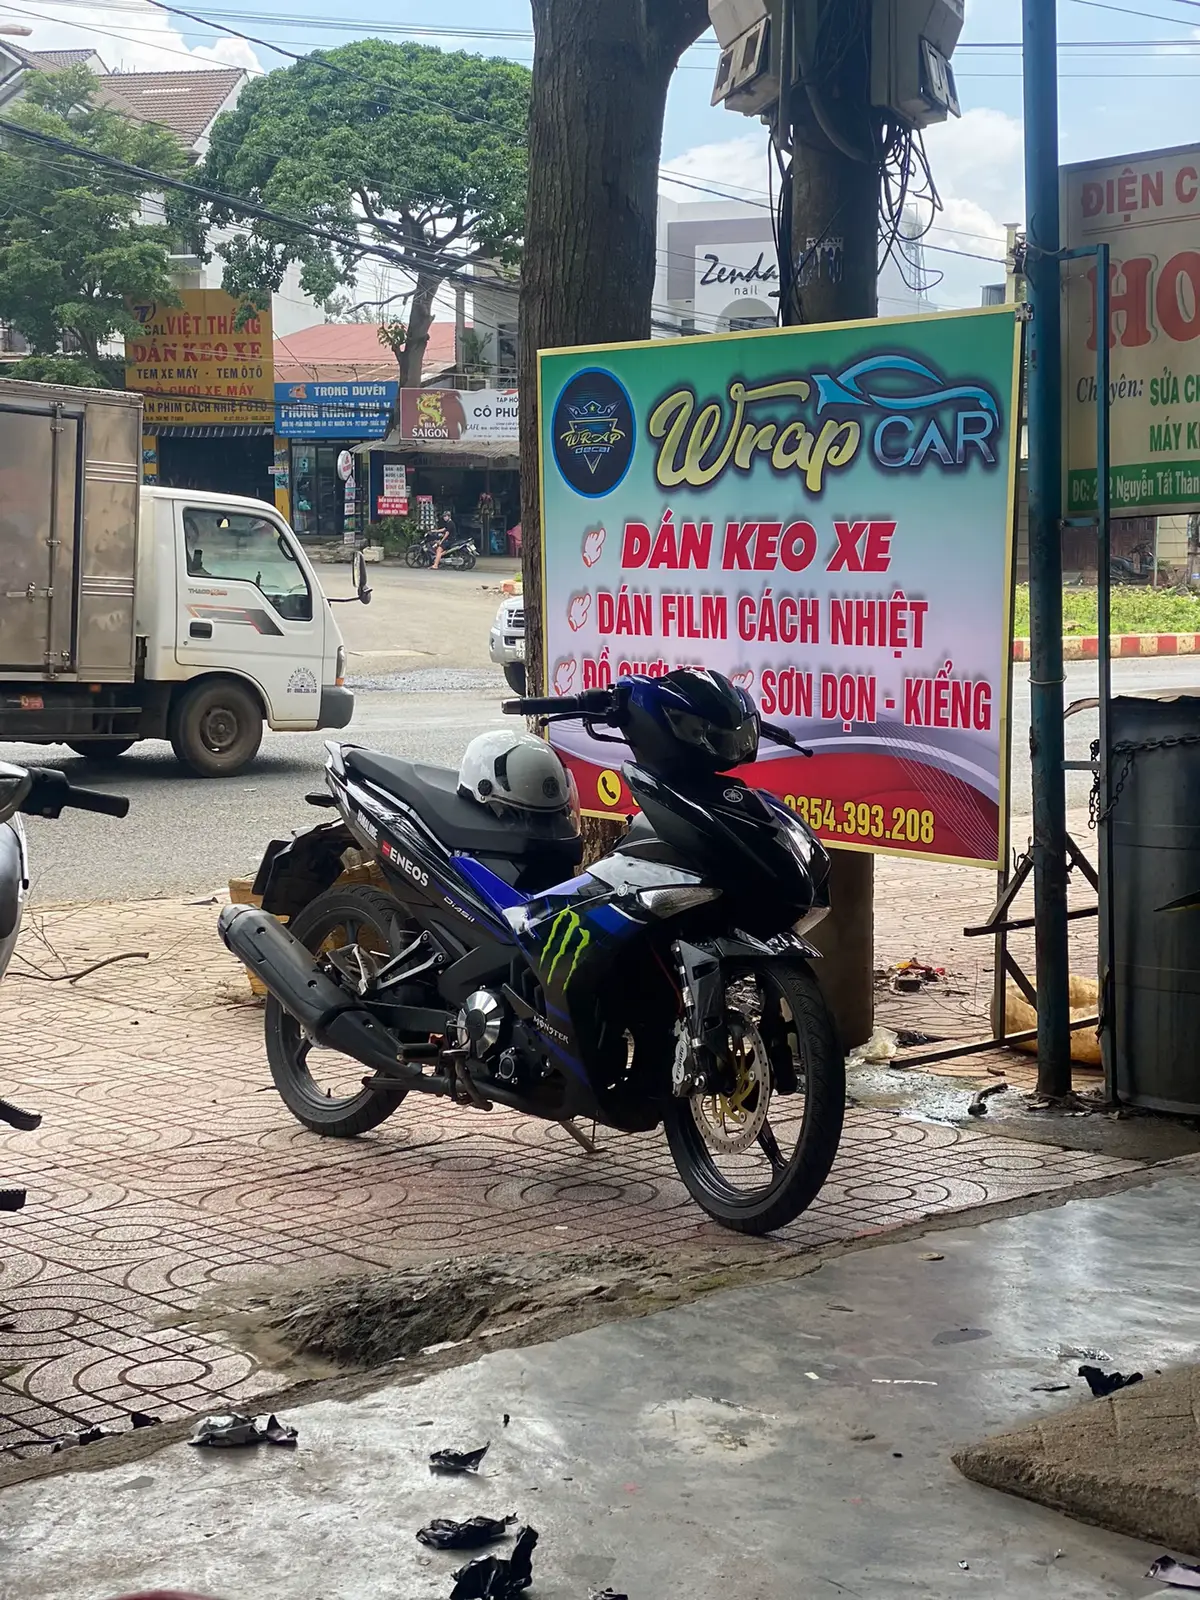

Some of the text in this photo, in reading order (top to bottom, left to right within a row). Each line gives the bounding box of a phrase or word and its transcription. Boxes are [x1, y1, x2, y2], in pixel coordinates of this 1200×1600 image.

[1080, 167, 1164, 222] ĐIỆN
[700, 252, 779, 285] Zenda
[734, 285, 758, 296] nail
[166, 312, 201, 338] VIỆT
[182, 342, 228, 362] KEO
[233, 342, 263, 361] XE
[137, 364, 263, 379] TEM XE MÁY TEM ÔTÔ
[1077, 374, 1144, 406] Chyên:
[1149, 366, 1180, 406] SỬA
[205, 386, 222, 396] XE
[226, 382, 255, 396] MÁY
[314, 386, 349, 398] TRỌNG
[158, 401, 182, 413] PHIM
[474, 404, 492, 418] CÔ
[412, 428, 449, 438] SAIGON
[566, 429, 621, 447] WRAP
[649, 381, 995, 492] Wrap CAR
[1149, 416, 1182, 452] MÁY
[1116, 469, 1154, 502] Nguyễn
[1156, 469, 1173, 496] Tất
[620, 508, 898, 572] DÁN KEO XE
[597, 584, 929, 659] DÁN FILM CÁCH NHIỆT
[582, 645, 612, 690] ĐỒ
[761, 666, 813, 718] SƠN
[820, 672, 877, 733] DỌN
[904, 659, 992, 731] KIỂNG
[389, 846, 430, 887] ENEOS
[533, 1015, 569, 1045] MONSTER
